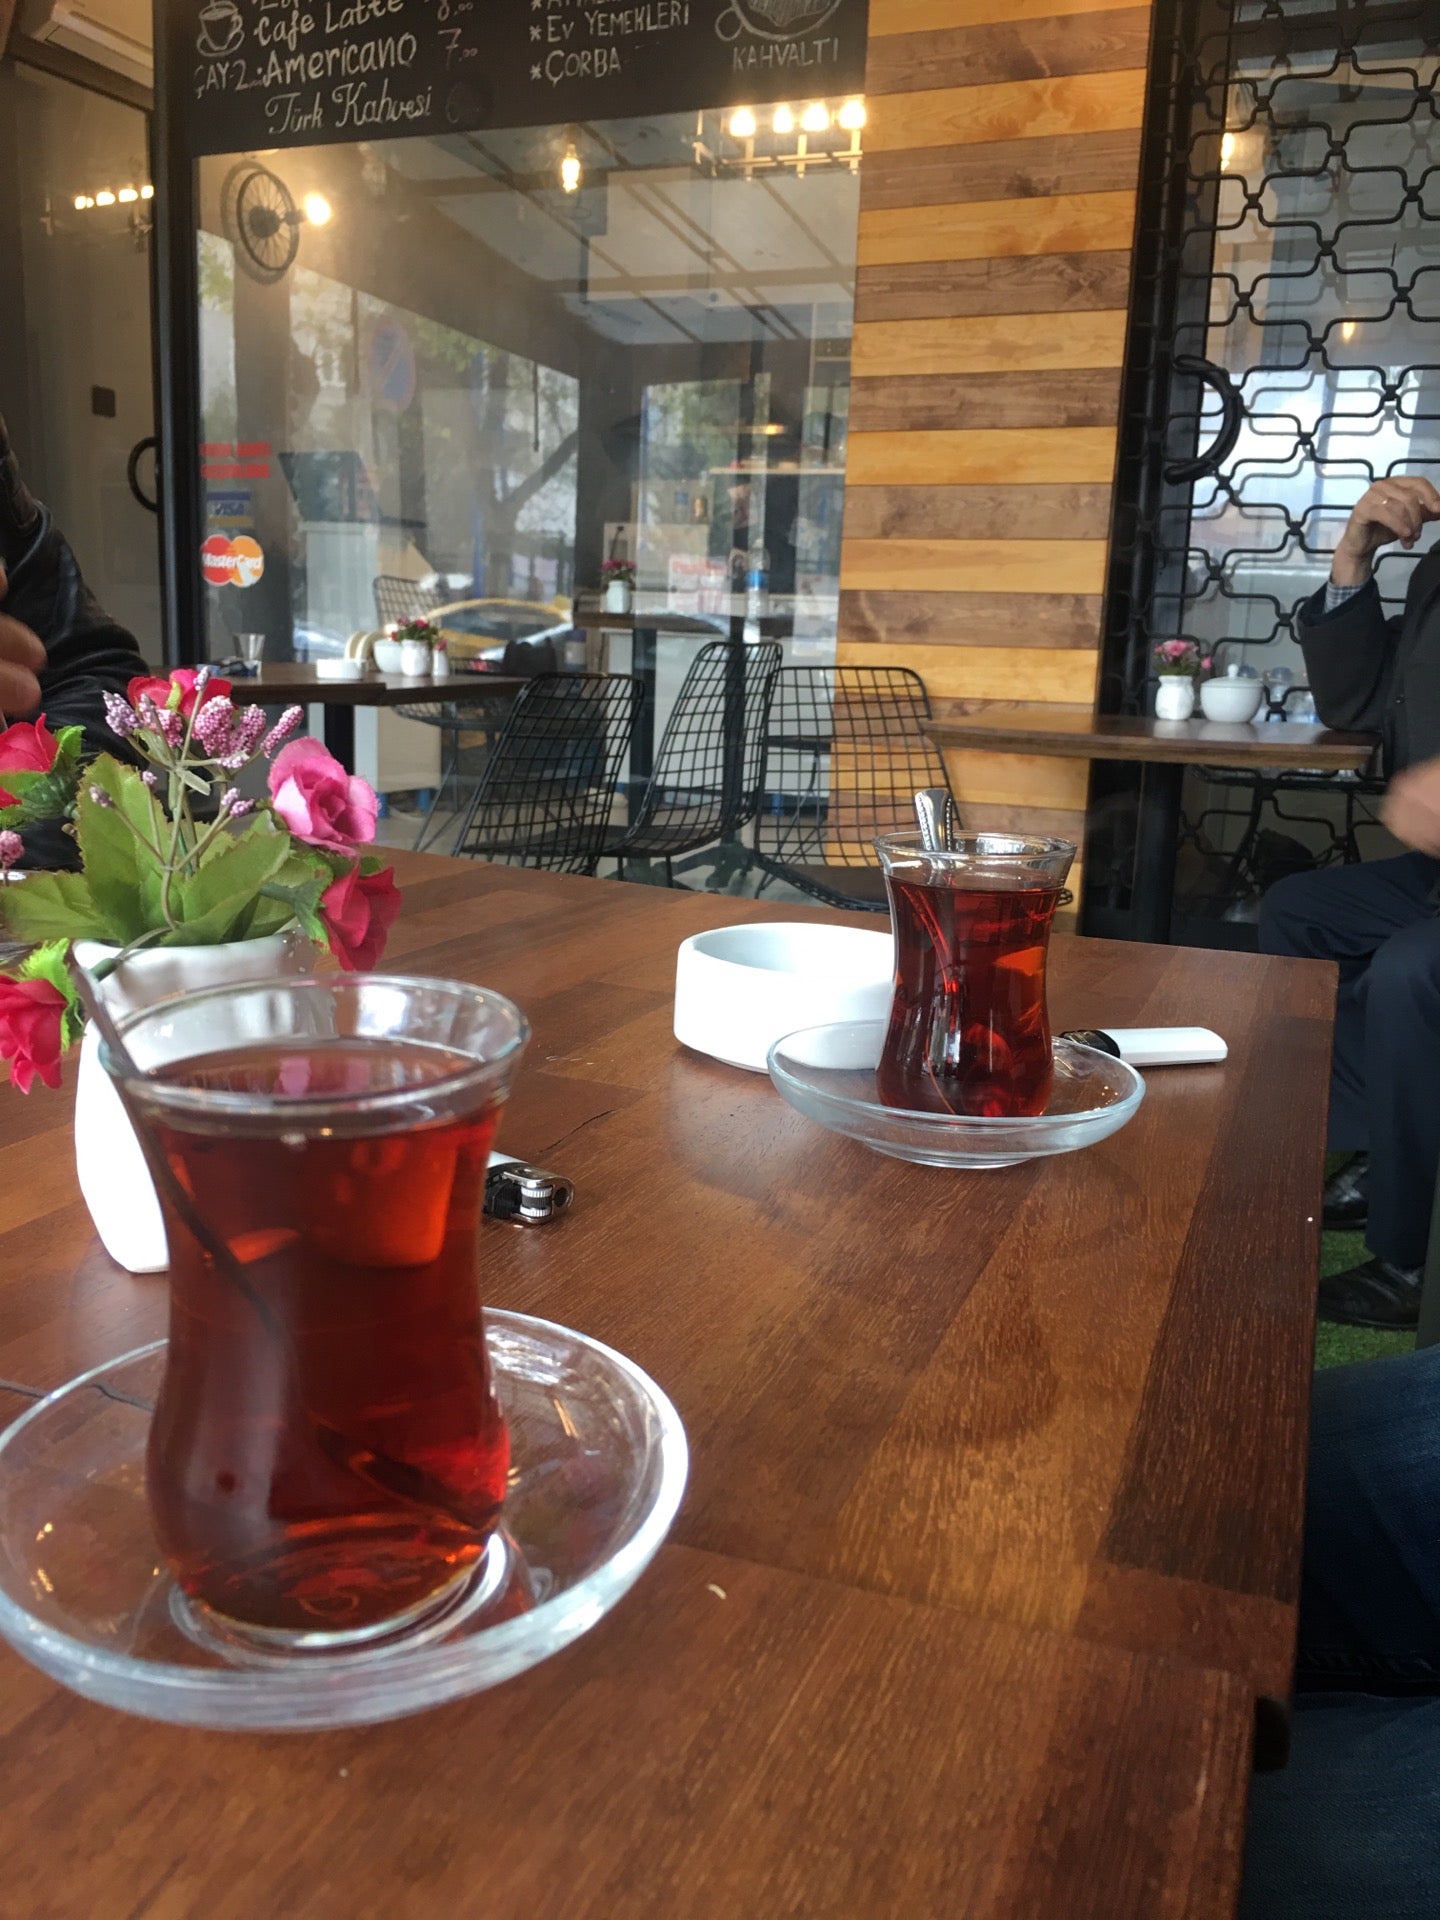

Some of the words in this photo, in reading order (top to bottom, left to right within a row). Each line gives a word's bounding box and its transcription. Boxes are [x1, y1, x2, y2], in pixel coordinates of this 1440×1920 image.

[258, 9, 316, 52] Cafe
[325, 0, 405, 34] Latte
[262, 31, 418, 88] Americano
[545, 46, 622, 88] ÇORBA
[732, 37, 839, 73] KAHVALTI
[264, 91, 324, 135] Türk
[331, 77, 433, 129] Kahvesi
